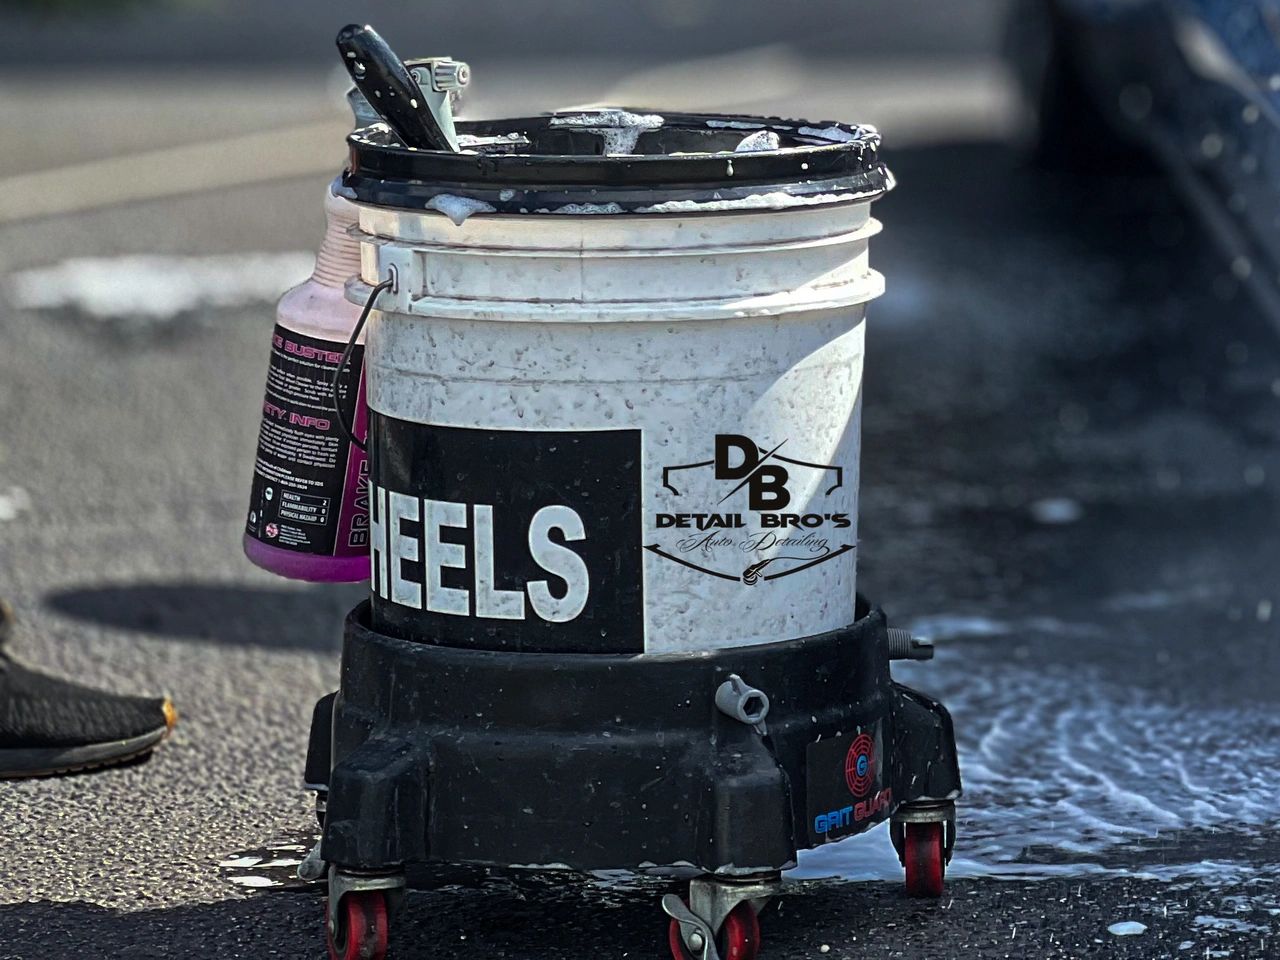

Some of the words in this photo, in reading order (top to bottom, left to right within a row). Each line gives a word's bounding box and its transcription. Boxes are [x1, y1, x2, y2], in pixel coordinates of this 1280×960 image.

[289, 412, 330, 430] INFO
[656, 513, 747, 531] DETAIL
[760, 513, 852, 531] BRO'S
[368, 480, 590, 623] HEELS
[676, 530, 734, 553] Auto
[738, 530, 829, 553] Detailing
[815, 806, 853, 833] GRIT
[854, 787, 892, 822] GUARD
